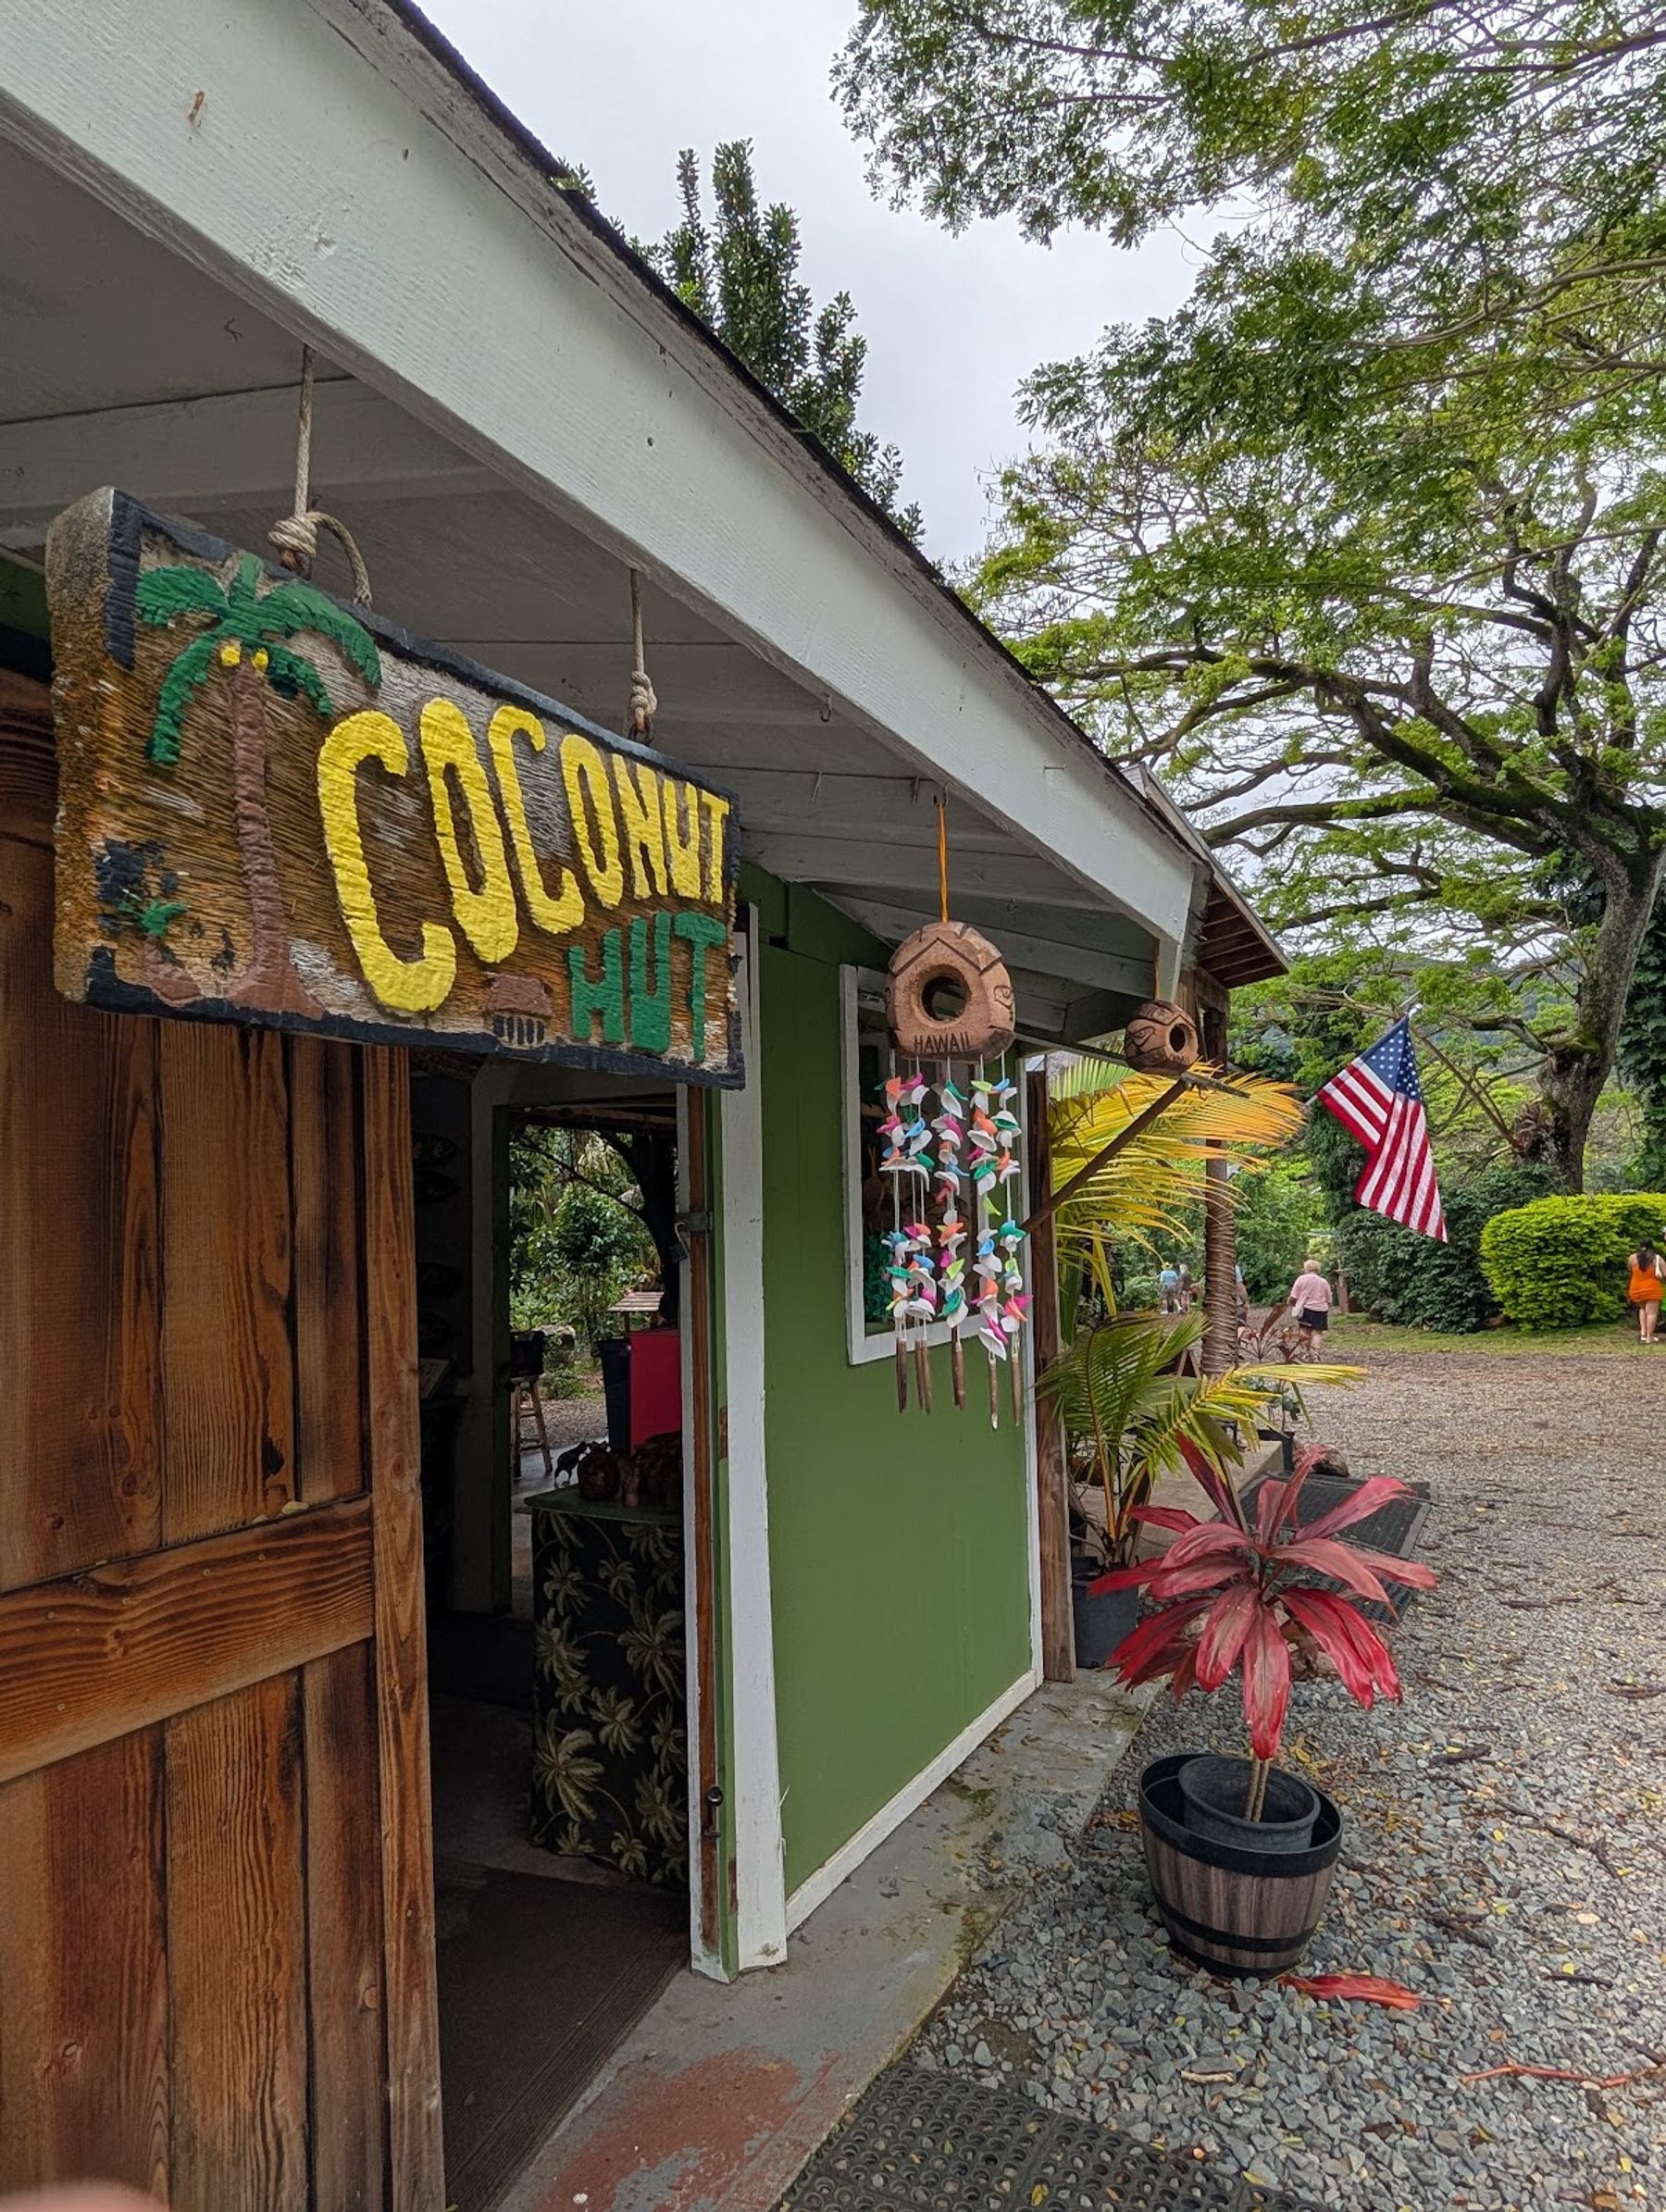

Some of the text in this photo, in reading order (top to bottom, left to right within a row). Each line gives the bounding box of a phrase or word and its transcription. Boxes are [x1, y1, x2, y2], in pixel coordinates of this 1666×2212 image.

[317, 697, 731, 1014] COCONUT
[566, 911, 727, 1063] HUT
[914, 1030, 971, 1054] HAWAII
